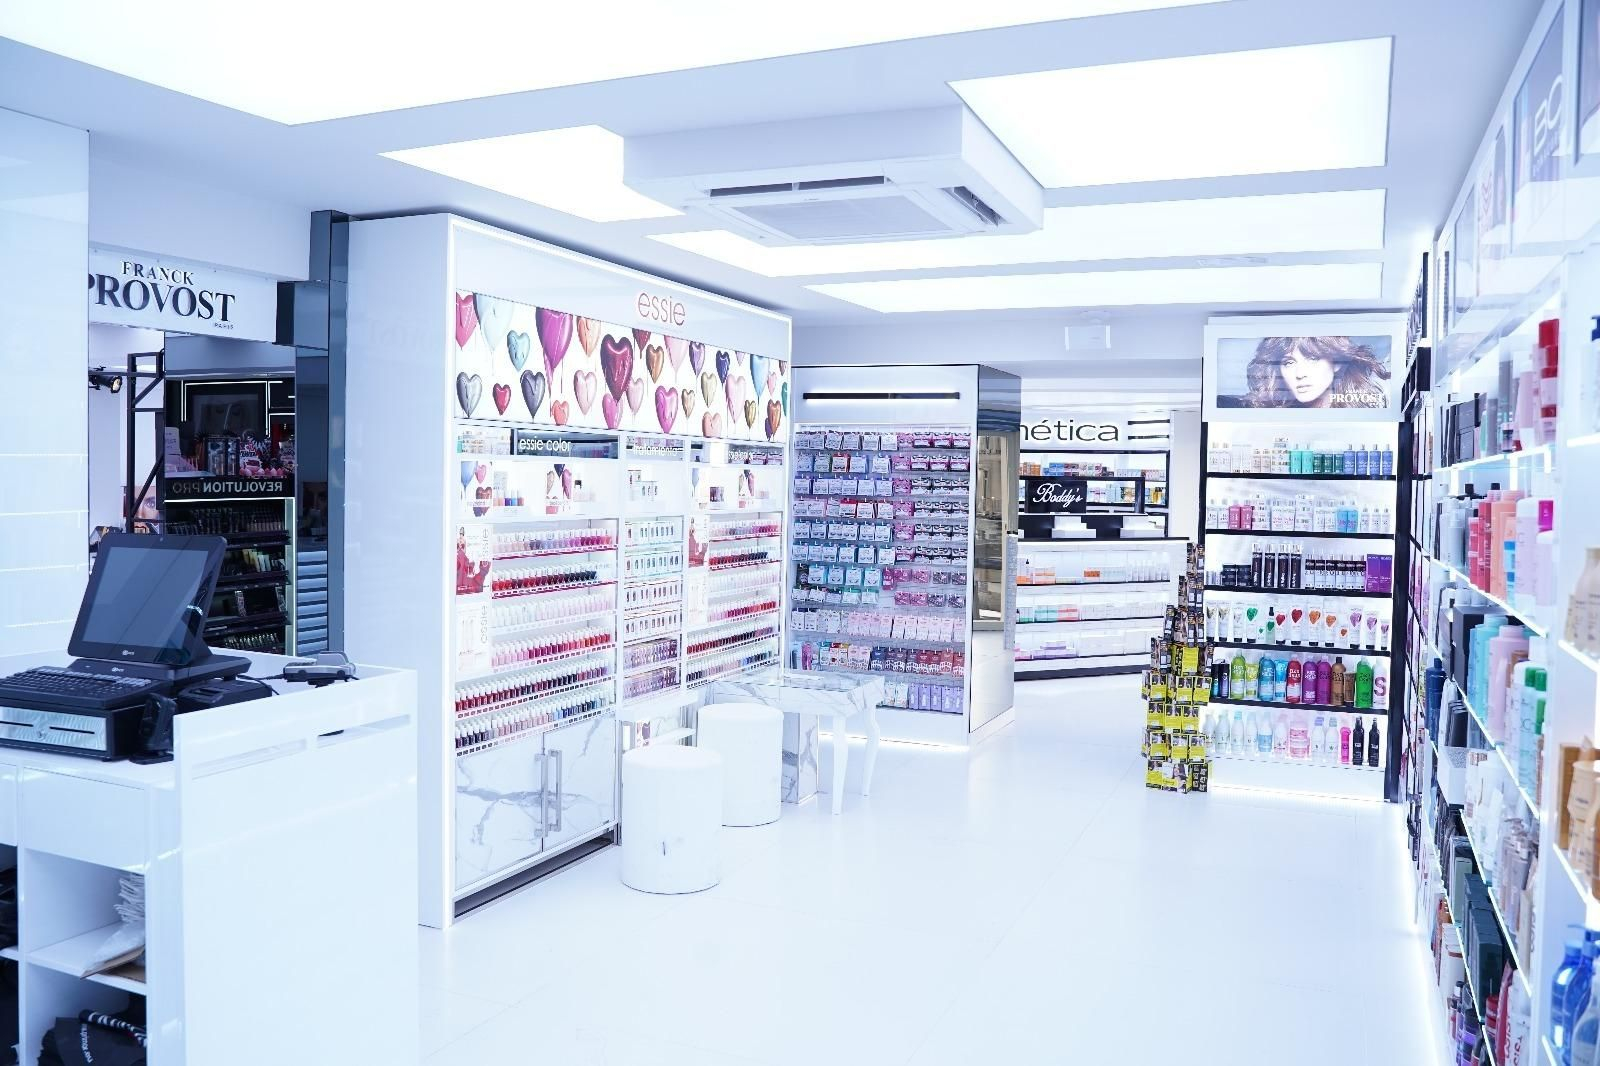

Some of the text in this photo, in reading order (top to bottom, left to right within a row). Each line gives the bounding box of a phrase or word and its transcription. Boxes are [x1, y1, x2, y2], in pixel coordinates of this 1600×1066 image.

[122, 261, 194, 285] FRANCK
[637, 292, 686, 326] essie
[519, 435, 571, 452] essie color
[1032, 482, 1083, 508] Boddy's
